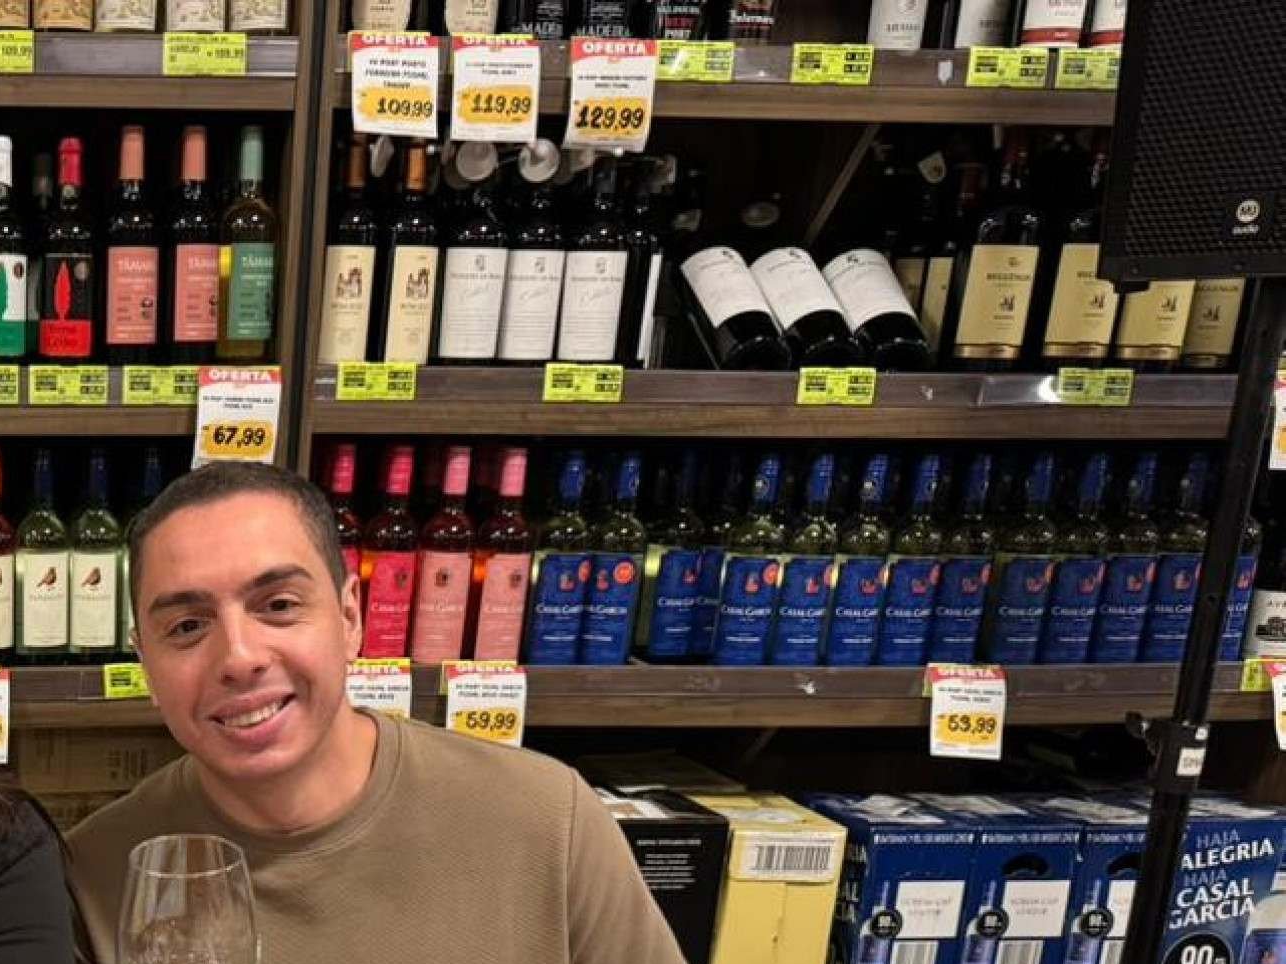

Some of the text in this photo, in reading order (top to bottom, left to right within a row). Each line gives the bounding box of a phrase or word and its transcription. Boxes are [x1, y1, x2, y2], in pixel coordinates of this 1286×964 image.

[361, 33, 428, 46] OFERTA
[582, 41, 647, 55] OFERTA
[375, 98, 433, 118] 109,99
[471, 93, 532, 115] 119,99
[575, 105, 645, 131] 129,99
[208, 368, 272, 382] OFERTA
[213, 425, 266, 449] 67,99
[1180, 837, 1276, 870] ALEGRIA
[1176, 877, 1255, 909] CASAL
[1168, 895, 1257, 929] GARCIA
